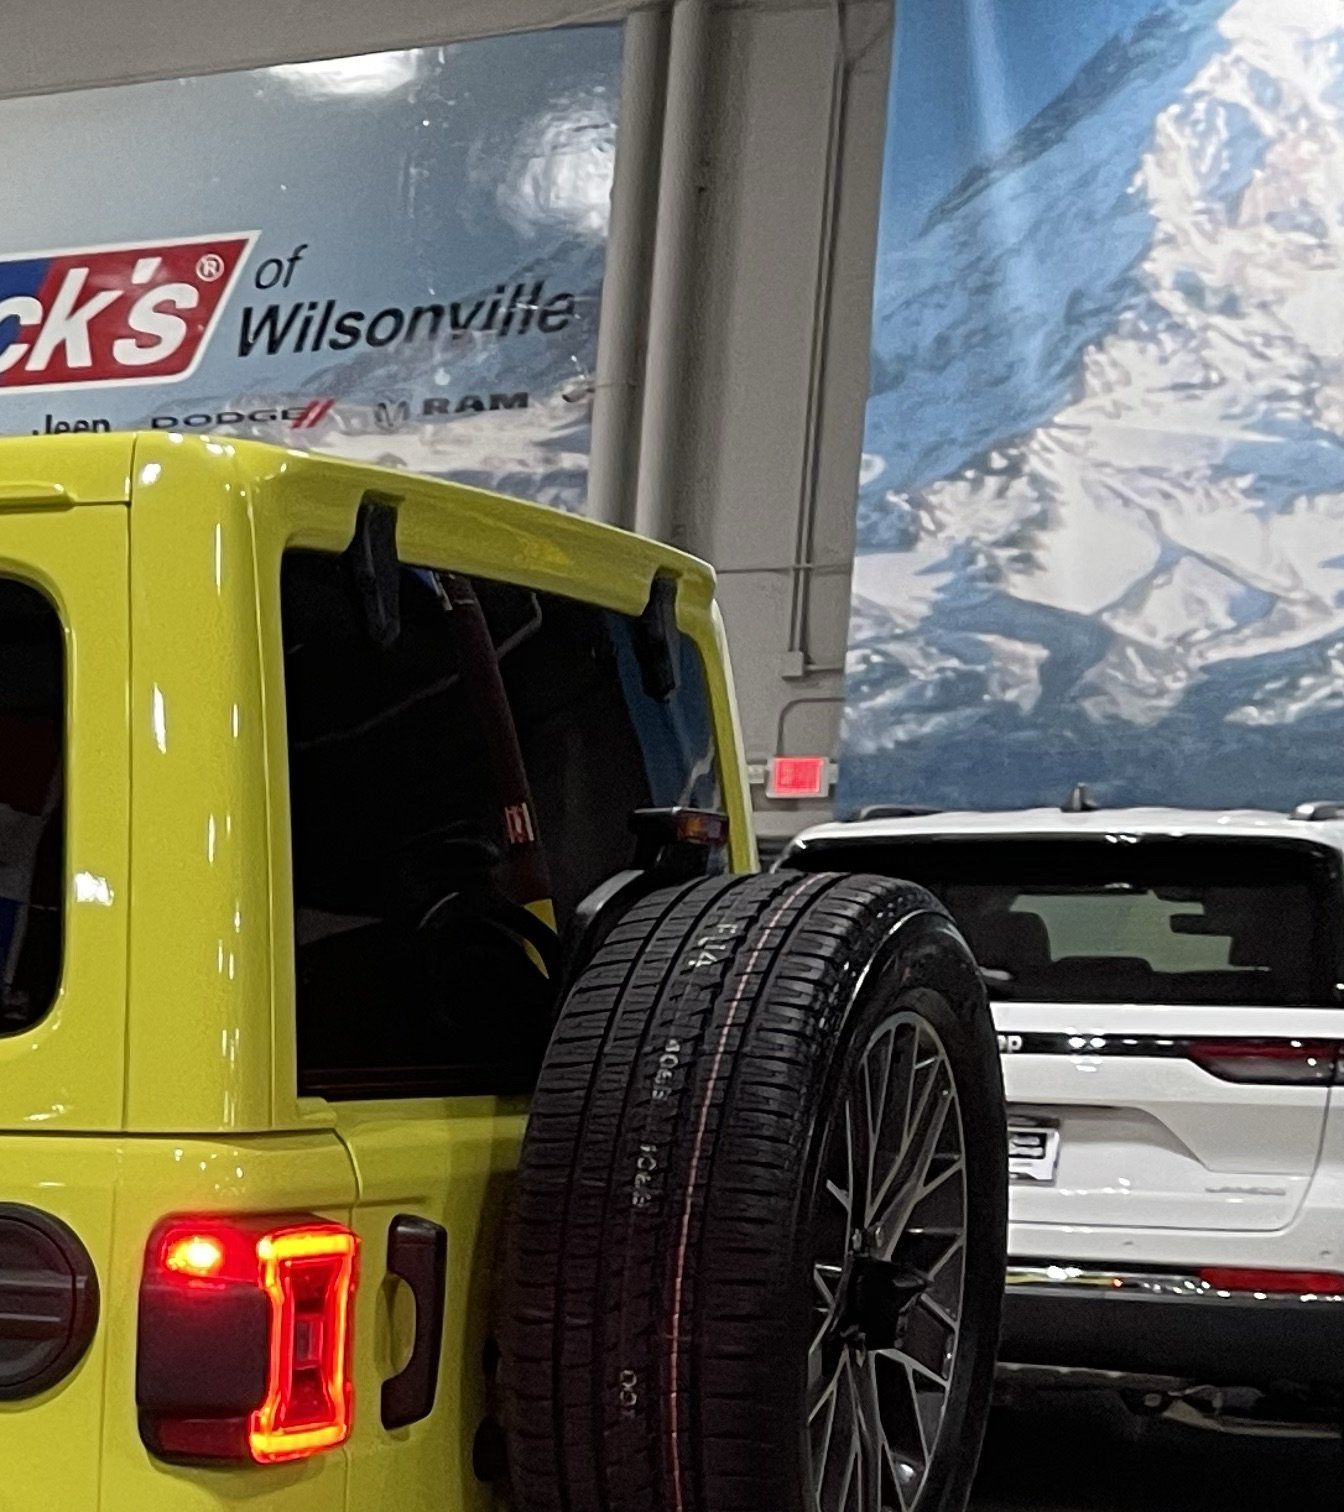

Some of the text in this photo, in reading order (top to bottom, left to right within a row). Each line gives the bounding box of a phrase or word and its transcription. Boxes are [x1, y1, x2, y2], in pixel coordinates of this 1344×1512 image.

[254, 243, 308, 290] of
[237, 279, 577, 358] Wilsonville
[151, 405, 306, 429] DODGE
[422, 392, 529, 416] RAM
